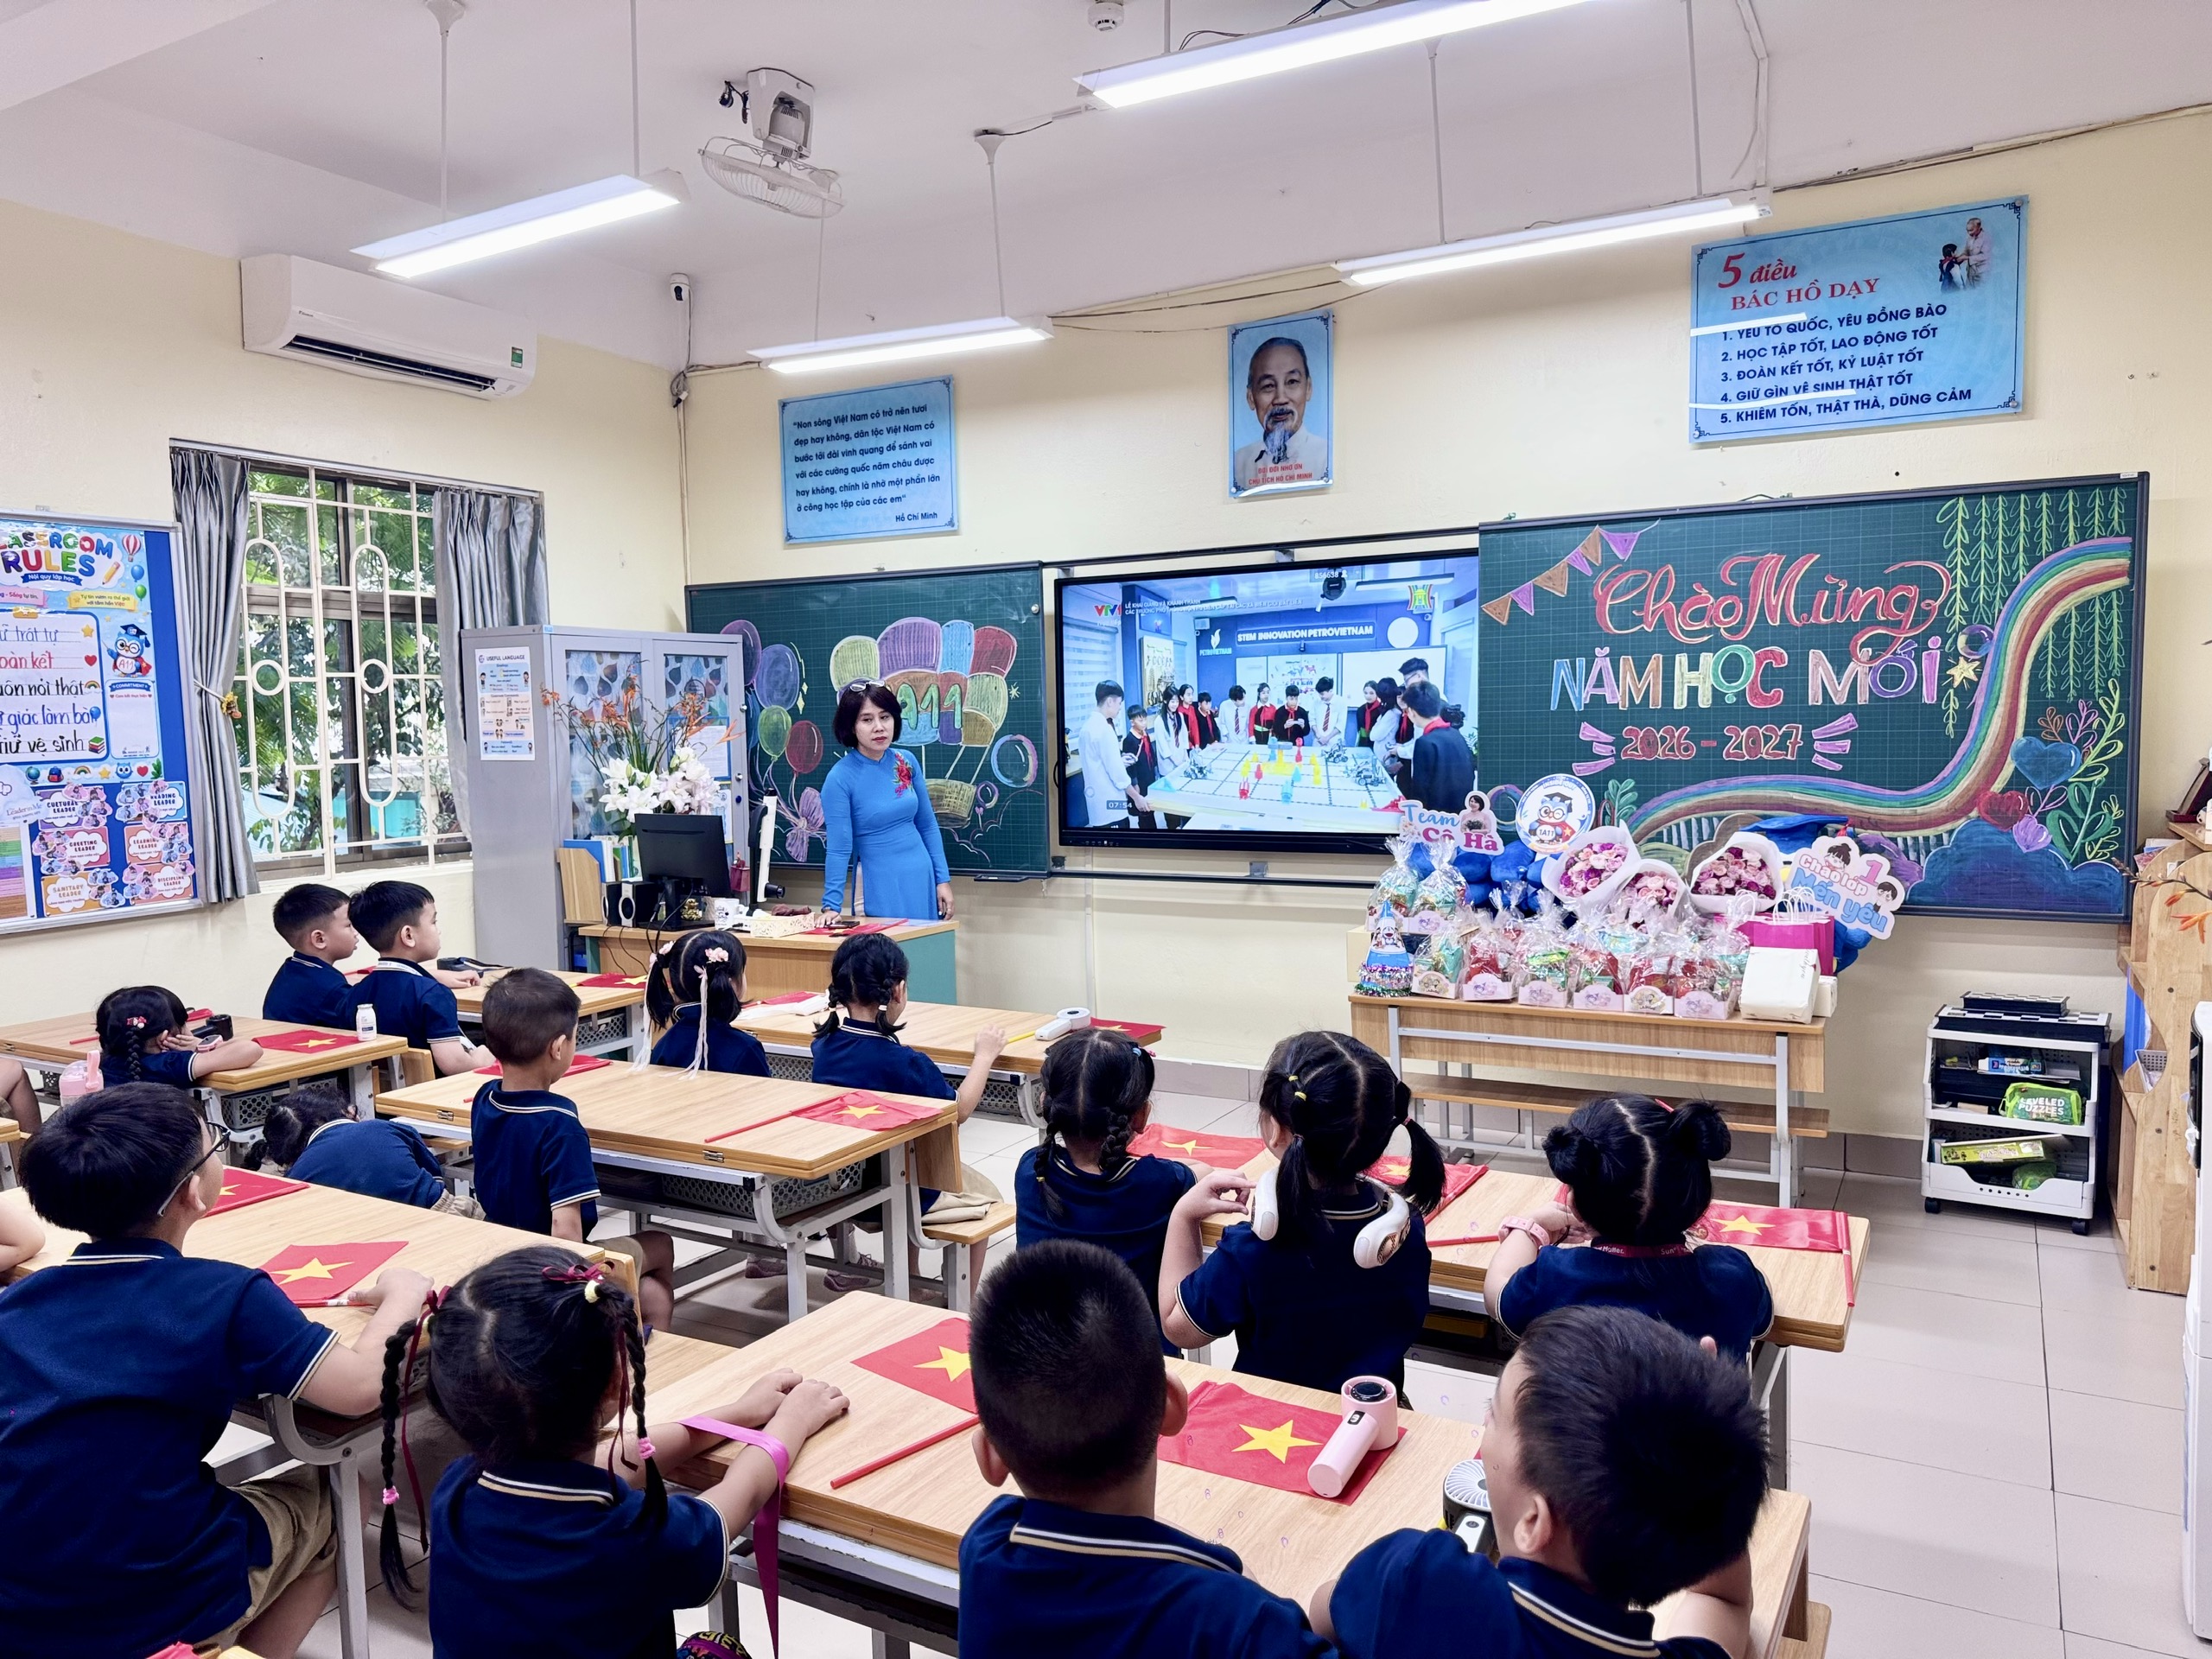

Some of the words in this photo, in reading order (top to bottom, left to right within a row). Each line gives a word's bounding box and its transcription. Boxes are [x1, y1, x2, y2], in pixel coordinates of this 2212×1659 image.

[1718, 252, 1745, 288] 5
[1749, 257, 1796, 283] điều
[1731, 289, 1777, 310] BÁC
[1785, 278, 1821, 303] HỒ
[1828, 277, 1879, 299] DẠY
[1722, 331, 1732, 340] 1.
[1785, 315, 1832, 334] QUỐC,
[1836, 313, 1861, 327] YÊU
[1866, 306, 1910, 324] ĐỒNG
[1915, 302, 1947, 318] BÀO
[1720, 351, 1732, 361] 2.
[1737, 346, 1767, 361] HỌC
[1770, 341, 1796, 357] TẬP
[1799, 336, 1827, 353] TỐT,
[1831, 336, 1859, 349] LAO
[1862, 330, 1907, 346] ĐỘNG
[1910, 322, 1938, 340] TỐT
[1720, 372, 1732, 382] 3.
[1736, 365, 1776, 380] ĐOÀN
[1780, 359, 1802, 376] KẾT
[1806, 356, 1834, 372] TỐT,
[1838, 354, 1856, 369] KỶ
[1860, 352, 1893, 368] LUẬT
[1897, 346, 1923, 363] TỐT
[1719, 392, 1732, 402] 4.
[1736, 387, 1760, 401] GIỮ
[1764, 385, 1788, 397] GÌN
[1812, 379, 1844, 392] SINH
[1848, 373, 1883, 389] THẬT
[1886, 369, 1913, 385] TỐT
[813, 417, 831, 427] sông
[833, 414, 848, 425] Việt
[849, 413, 868, 422] Nam
[869, 409, 880, 419] có
[894, 406, 909, 416] nên
[911, 404, 927, 413] tươi
[1719, 412, 1731, 423] 5.
[1736, 407, 1777, 422] KHIÊM
[1780, 404, 1811, 417] TỐN,
[1815, 399, 1850, 415] THẬT
[1853, 395, 1885, 410] THÀ,
[1889, 392, 1931, 407] DŨNG
[1936, 387, 1971, 402] CẢM
[793, 438, 808, 447] đẹp
[810, 435, 824, 444] hay
[826, 432, 852, 442] không,
[854, 429, 869, 438] dân
[871, 427, 883, 438] tộc
[886, 425, 900, 435] Việt
[903, 423, 922, 432] Nam
[924, 420, 934, 429] có
[794, 453, 813, 462] bước
[815, 451, 824, 460] tới
[826, 449, 839, 459] đài
[841, 448, 856, 457] vinh
[858, 446, 884, 456] quang
[886, 440, 896, 451] để
[898, 441, 917, 450] sánh
[919, 438, 931, 447] vai
[795, 470, 806, 479] với
[808, 468, 823, 477] các
[824, 466, 849, 475] cường
[850, 462, 870, 474] quốc
[872, 461, 889, 470] năm
[891, 459, 912, 468] châu
[913, 457, 934, 467] được
[795, 488, 810, 497] hay
[811, 485, 836, 495] không,
[838, 482, 860, 492] chính
[861, 480, 869, 490] là
[871, 479, 886, 489] nhờ
[887, 477, 903, 487] một
[905, 473, 925, 486] phần
[927, 474, 940, 482] lớn
[803, 502, 823, 512] công
[824, 501, 838, 511] học
[840, 499, 854, 510] tập
[855, 497, 870, 506] của
[872, 495, 887, 505] các
[906, 512, 918, 521] Chí
[920, 511, 938, 519] Minh
[0, 530, 113, 559] ASSROOM
[0, 549, 96, 577] RULES
[1314, 570, 1338, 579] 856638
[1094, 604, 1122, 616] VTV1
[1593, 563, 1743, 644] Chào
[1720, 553, 1952, 666] Mừng
[1237, 631, 1256, 642] STEM
[1258, 628, 1307, 641] INNOVATION
[1307, 625, 1373, 639] PETROVIETNAM
[1550, 646, 1662, 711] NĂM
[1674, 644, 1788, 709] HỌC
[52, 729, 84, 752] sinh
[1620, 725, 1696, 760] 2026
[1722, 723, 1802, 760] 2027
[1402, 804, 1460, 828] Team
[1464, 832, 1499, 852] Hà
[1840, 873, 1868, 897] lớp
[1859, 860, 1883, 887] 1
[1791, 867, 1841, 910] Mến
[1840, 898, 1888, 933] yêu
[2018, 1103, 2064, 1116] PUZZLES
[2019, 1097, 2065, 1108] LEVELED
